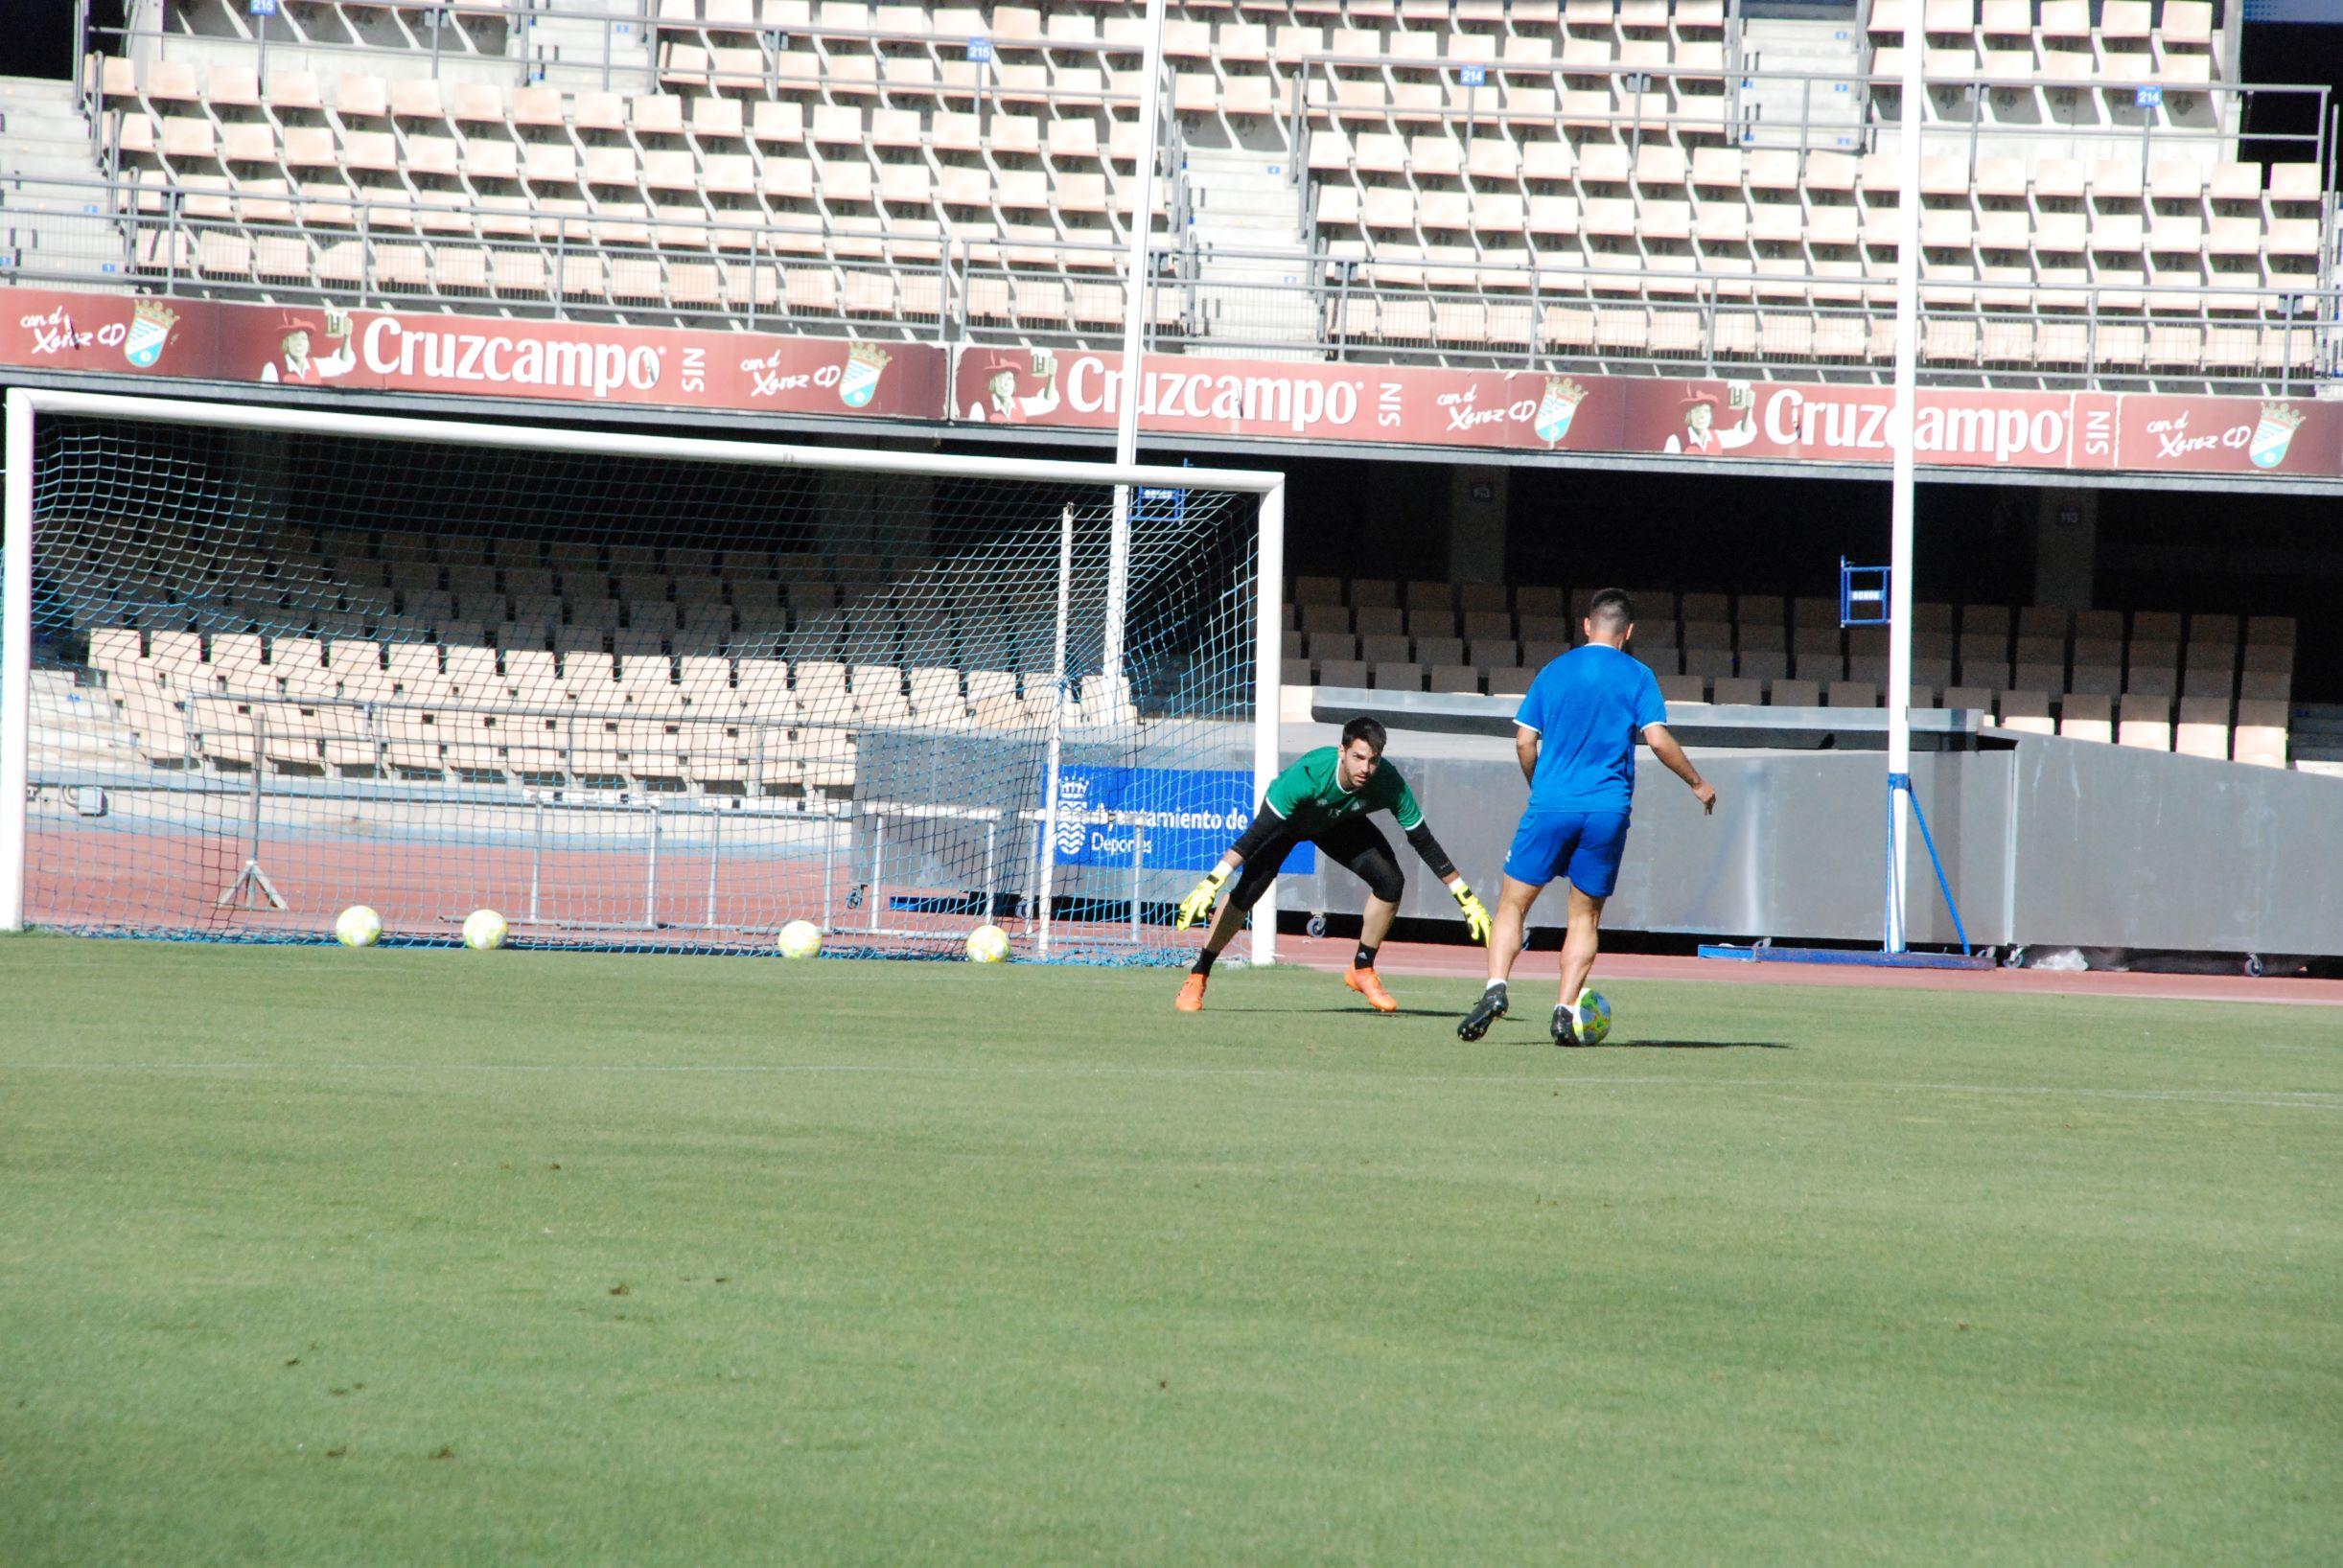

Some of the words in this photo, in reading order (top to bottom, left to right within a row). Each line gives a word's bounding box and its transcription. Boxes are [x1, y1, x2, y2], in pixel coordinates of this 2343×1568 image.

[2139, 91, 2160, 103] 214
[97, 323, 126, 347] CD
[363, 317, 661, 397] Cruzcampo
[682, 348, 705, 392] SIN
[813, 365, 841, 387] CD
[1379, 383, 1403, 427] SIN
[1508, 400, 1537, 422] CD
[2086, 411, 2111, 455] SIN
[2222, 426, 2252, 449] CD
[1225, 808, 1248, 830] de
[1091, 832, 1152, 856] Depors
